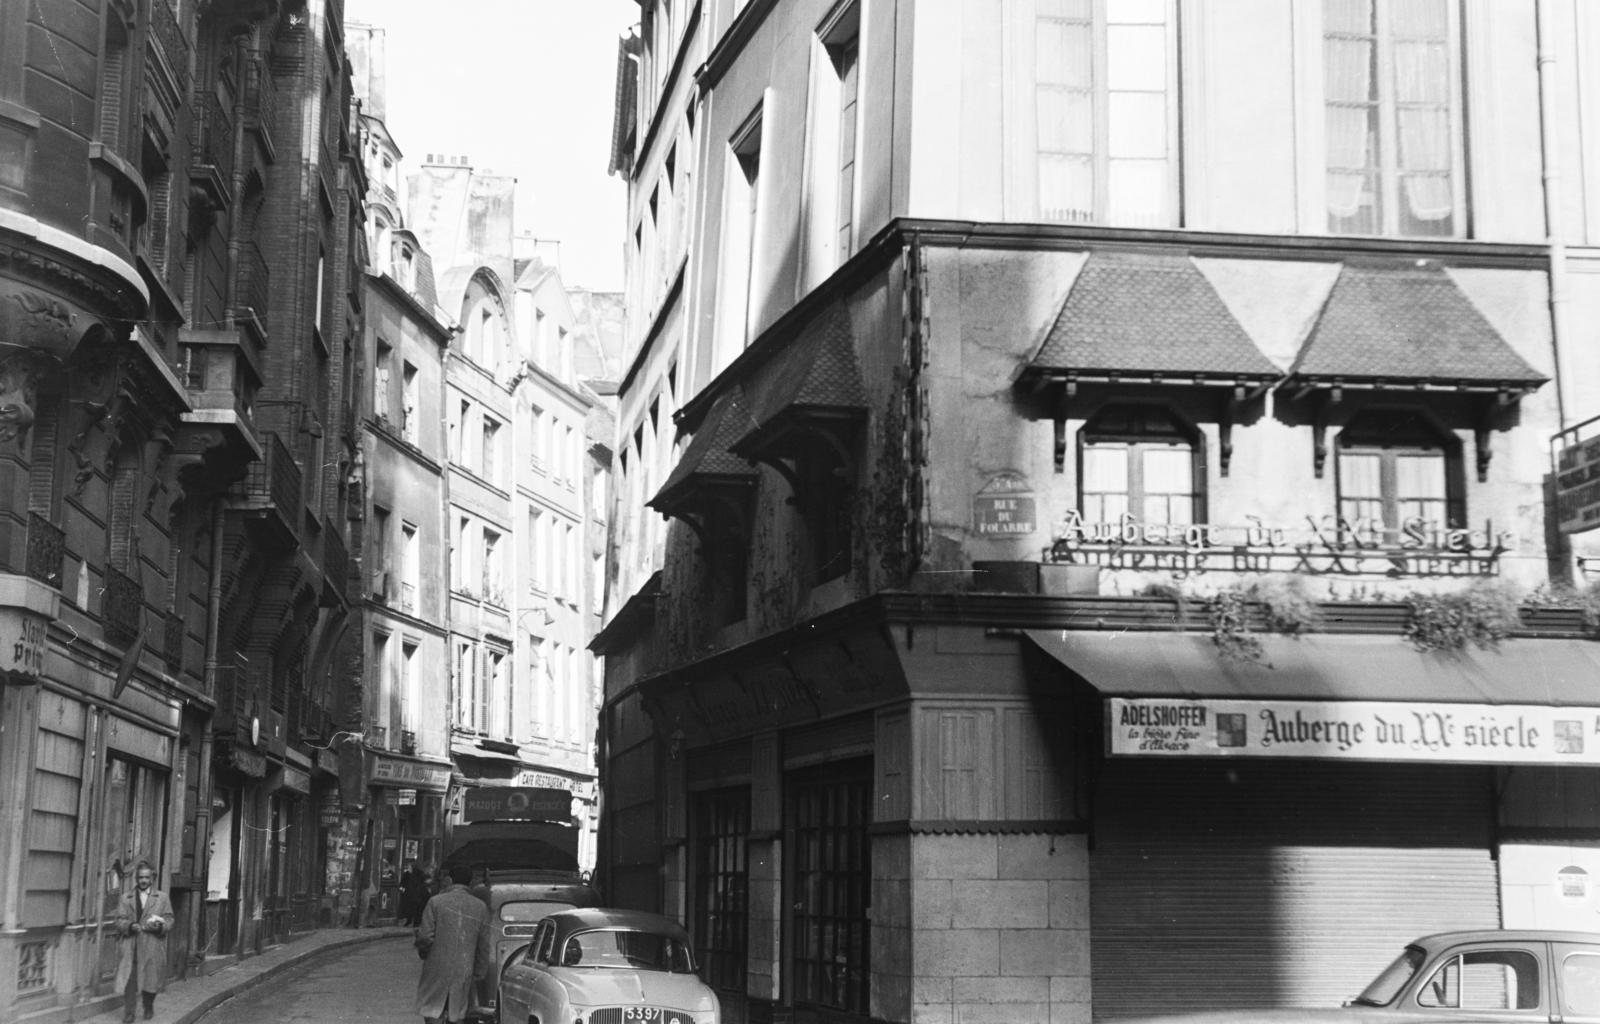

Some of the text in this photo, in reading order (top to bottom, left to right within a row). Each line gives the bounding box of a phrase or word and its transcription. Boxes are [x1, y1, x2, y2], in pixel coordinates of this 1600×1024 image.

[994, 499, 1018, 510] RUE
[998, 511, 1013, 521] DU
[980, 522, 1033, 533] FOUARRE
[1060, 508, 1223, 553] Auberge
[1120, 704, 1207, 727] ADELSHOFFEN
[1259, 708, 1365, 751] Auberge
[1374, 713, 1406, 744] du
[1464, 715, 1540, 748] siècle
[1128, 728, 1139, 739] la
[1138, 739, 1191, 751] d'Alsace
[535, 774, 567, 791] RESTAURANT
[626, 1007, 660, 1020] 5397
